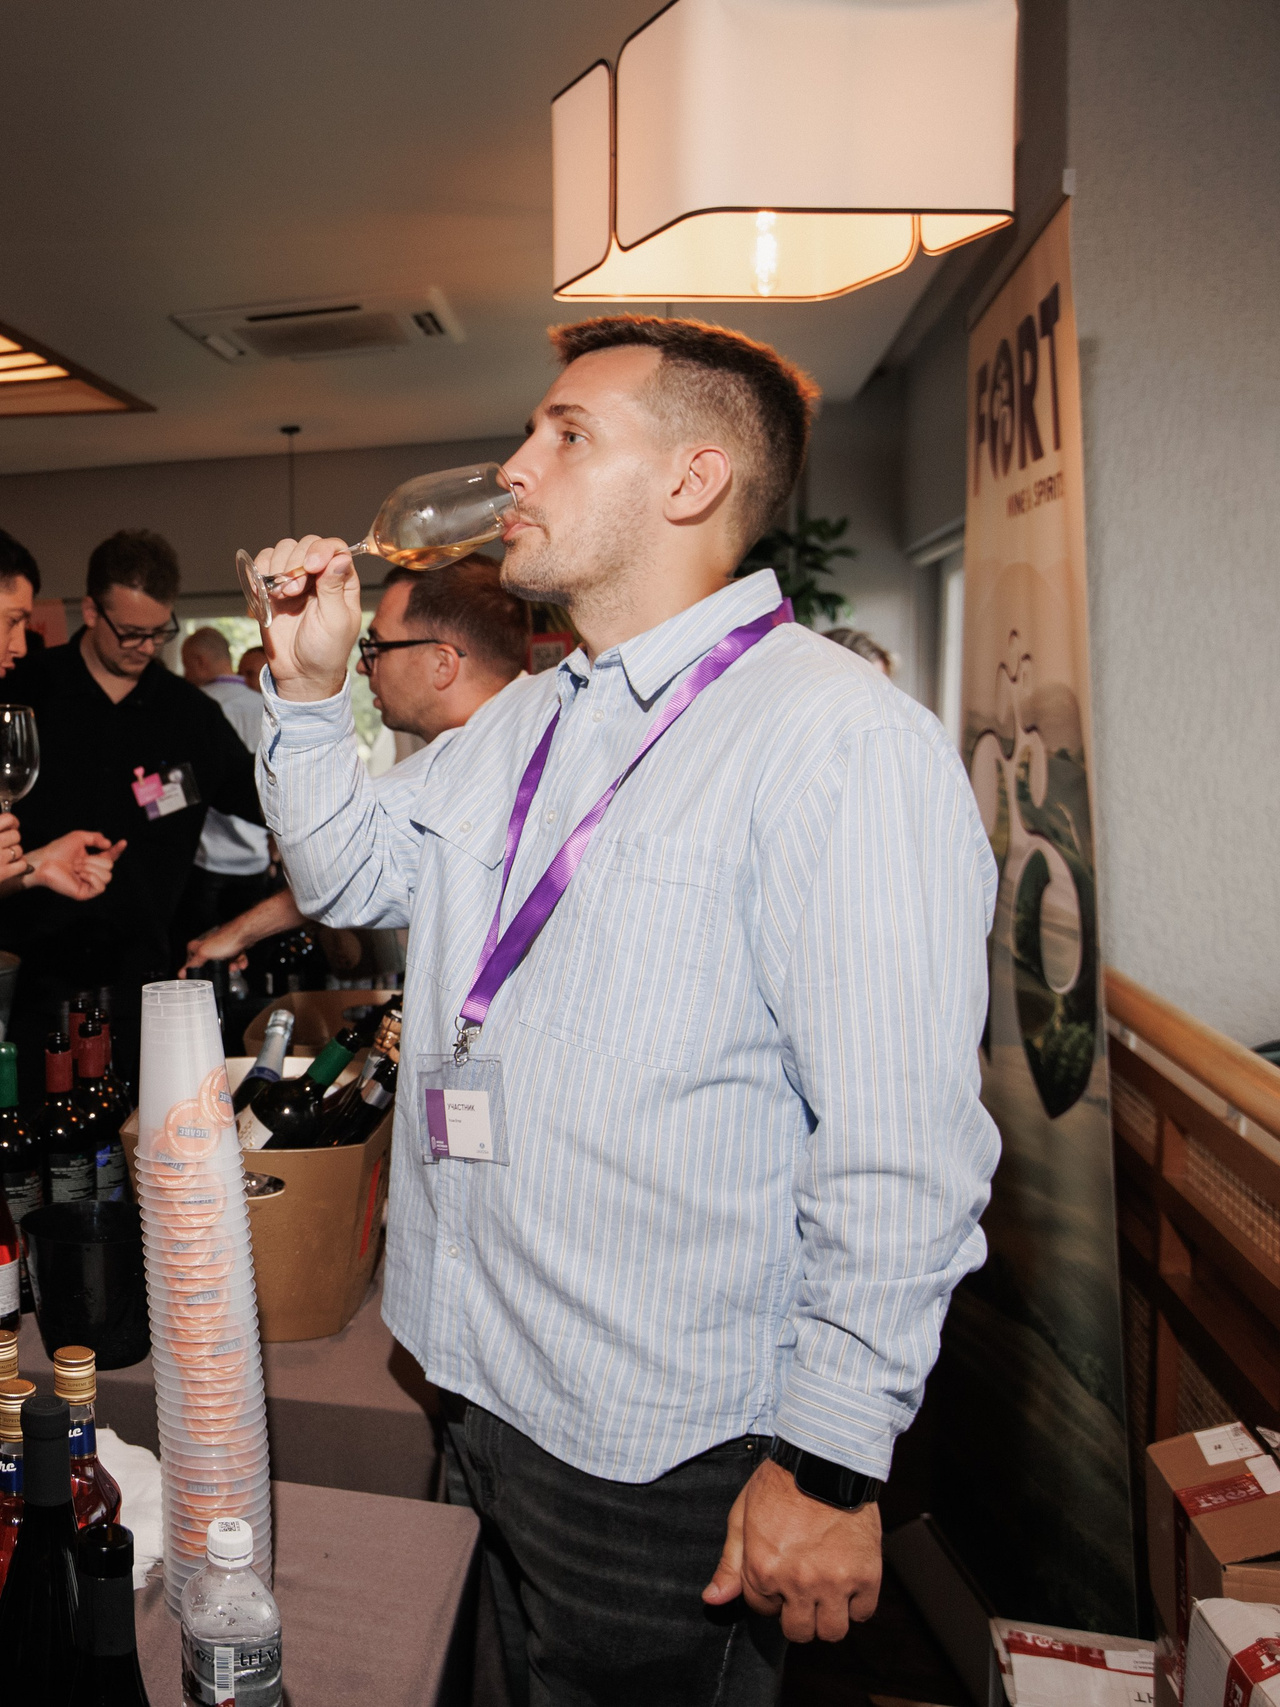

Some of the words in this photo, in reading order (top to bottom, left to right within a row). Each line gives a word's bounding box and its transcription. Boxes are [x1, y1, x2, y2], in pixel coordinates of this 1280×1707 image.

[972, 281, 1061, 497] FORT
[447, 1103, 476, 1111] УЧАСТНИК
[179, 1127, 209, 1138] LIGARE
[239, 1649, 262, 1667] tri
